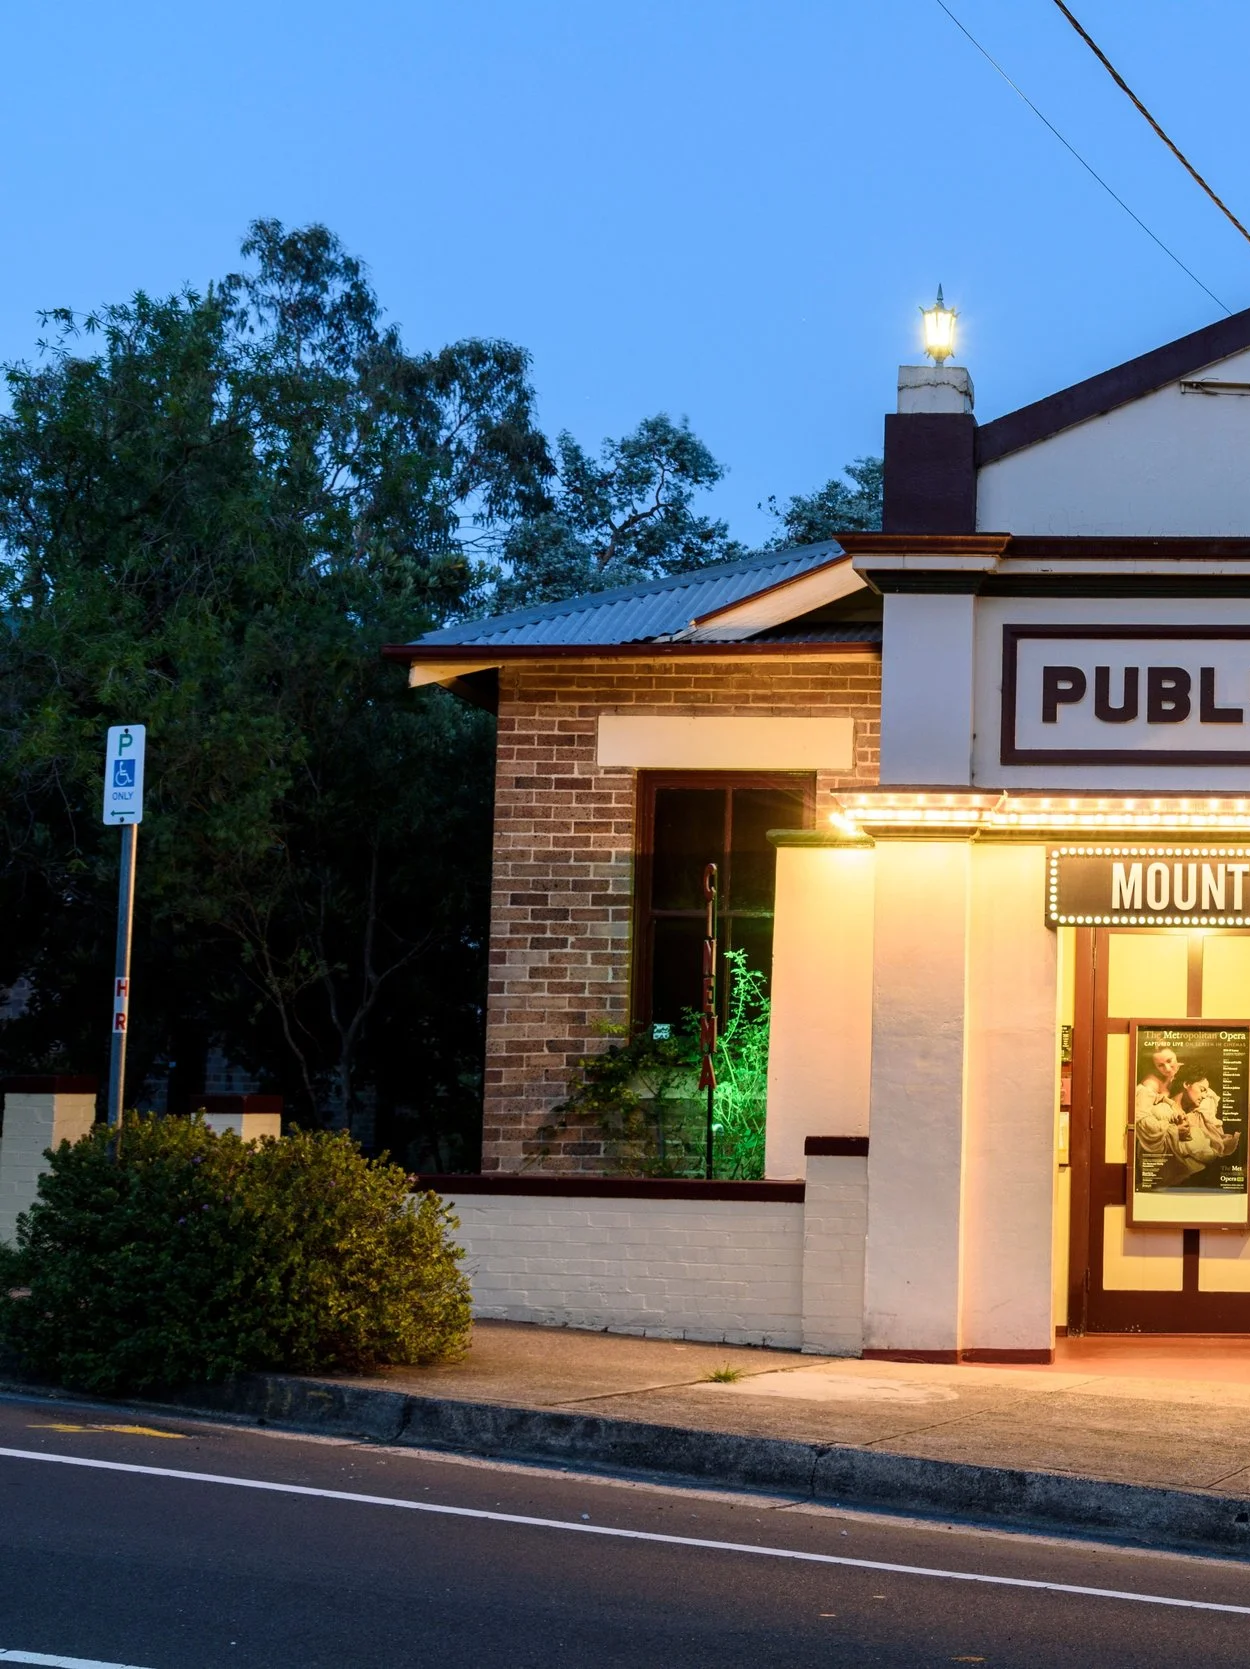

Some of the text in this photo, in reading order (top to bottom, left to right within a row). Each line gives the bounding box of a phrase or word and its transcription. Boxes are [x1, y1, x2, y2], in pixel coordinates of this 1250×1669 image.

[118, 733, 133, 756] P
[111, 792, 134, 801] ONLY
[1111, 862, 1250, 911] MOUNT
[1144, 1030, 1246, 1041] The Metropolitan Opera
